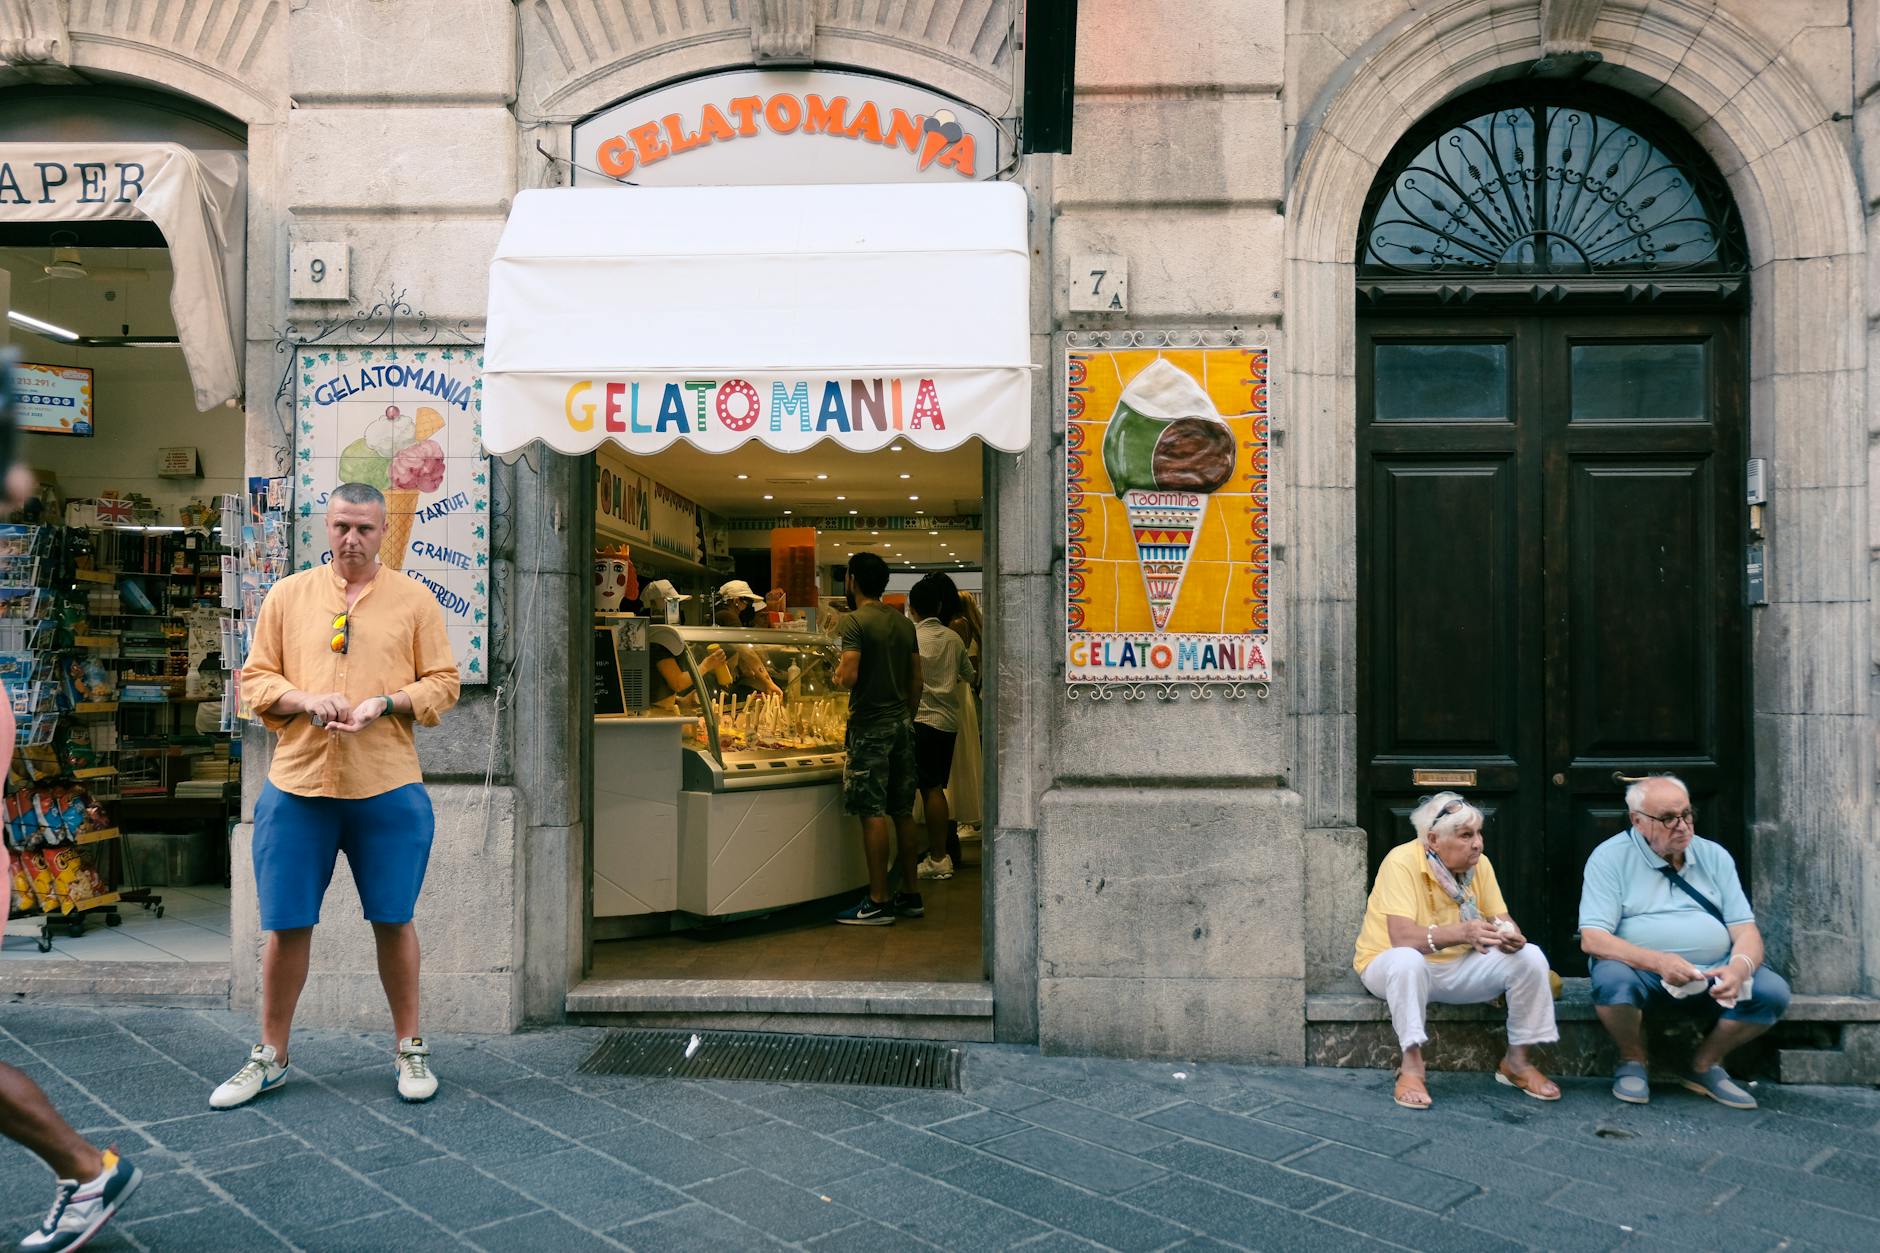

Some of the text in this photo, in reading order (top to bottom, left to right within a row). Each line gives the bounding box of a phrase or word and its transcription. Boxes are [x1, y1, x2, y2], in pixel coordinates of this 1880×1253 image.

[597, 93, 977, 178] GELATOMANIA
[0, 162, 145, 204] APER
[310, 258, 327, 284] 9
[1089, 269, 1124, 309] 7 A
[314, 364, 472, 411] GELATOMANIA
[565, 378, 947, 434] GELATOMANIA
[415, 491, 469, 524] TARTUFI
[1129, 492, 1199, 507] Taormina
[411, 540, 471, 571] GRANITE
[1070, 641, 1266, 670] GELATOMANIA
